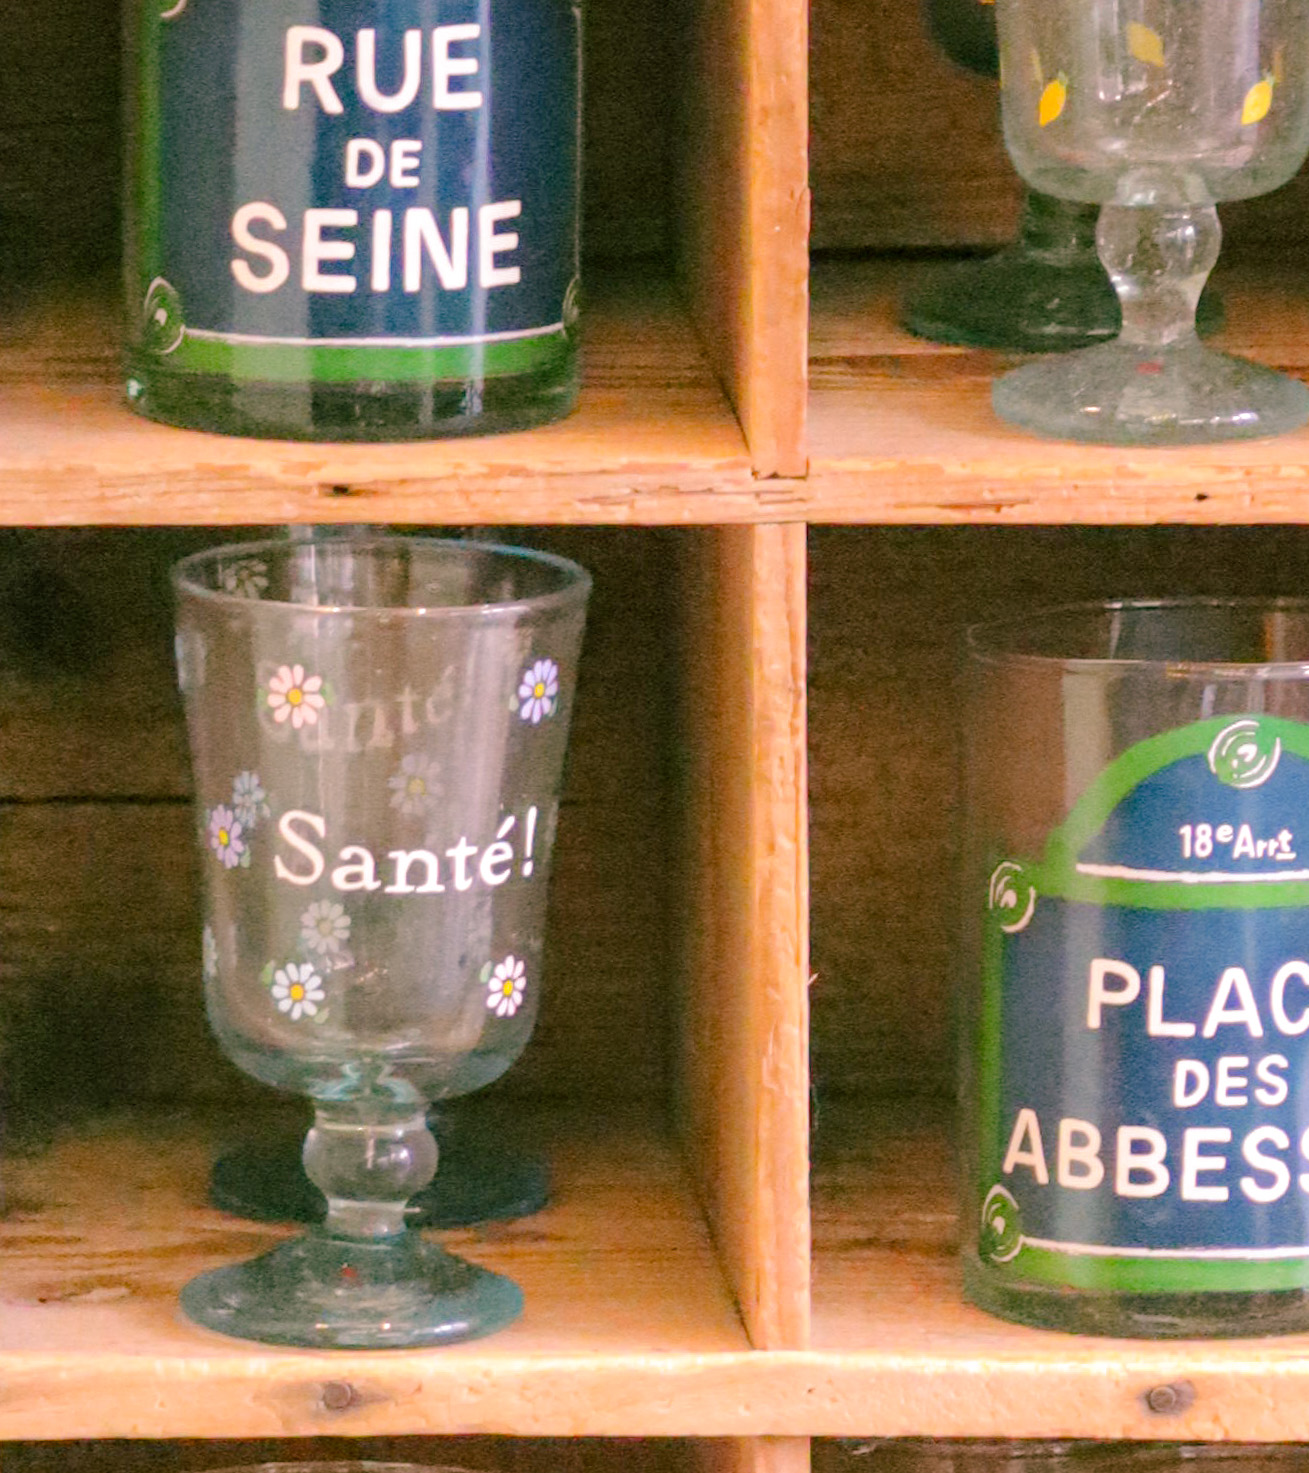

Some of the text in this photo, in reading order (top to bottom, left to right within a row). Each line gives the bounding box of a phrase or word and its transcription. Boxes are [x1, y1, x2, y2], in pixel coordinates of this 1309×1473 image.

[282, 23, 484, 116] RUE
[344, 137, 423, 189] DE
[229, 199, 523, 295] SEINE
[274, 805, 538, 894] Santé!
[1231, 823, 1297, 862] Arrt
[1172, 1053, 1290, 1109] DES
